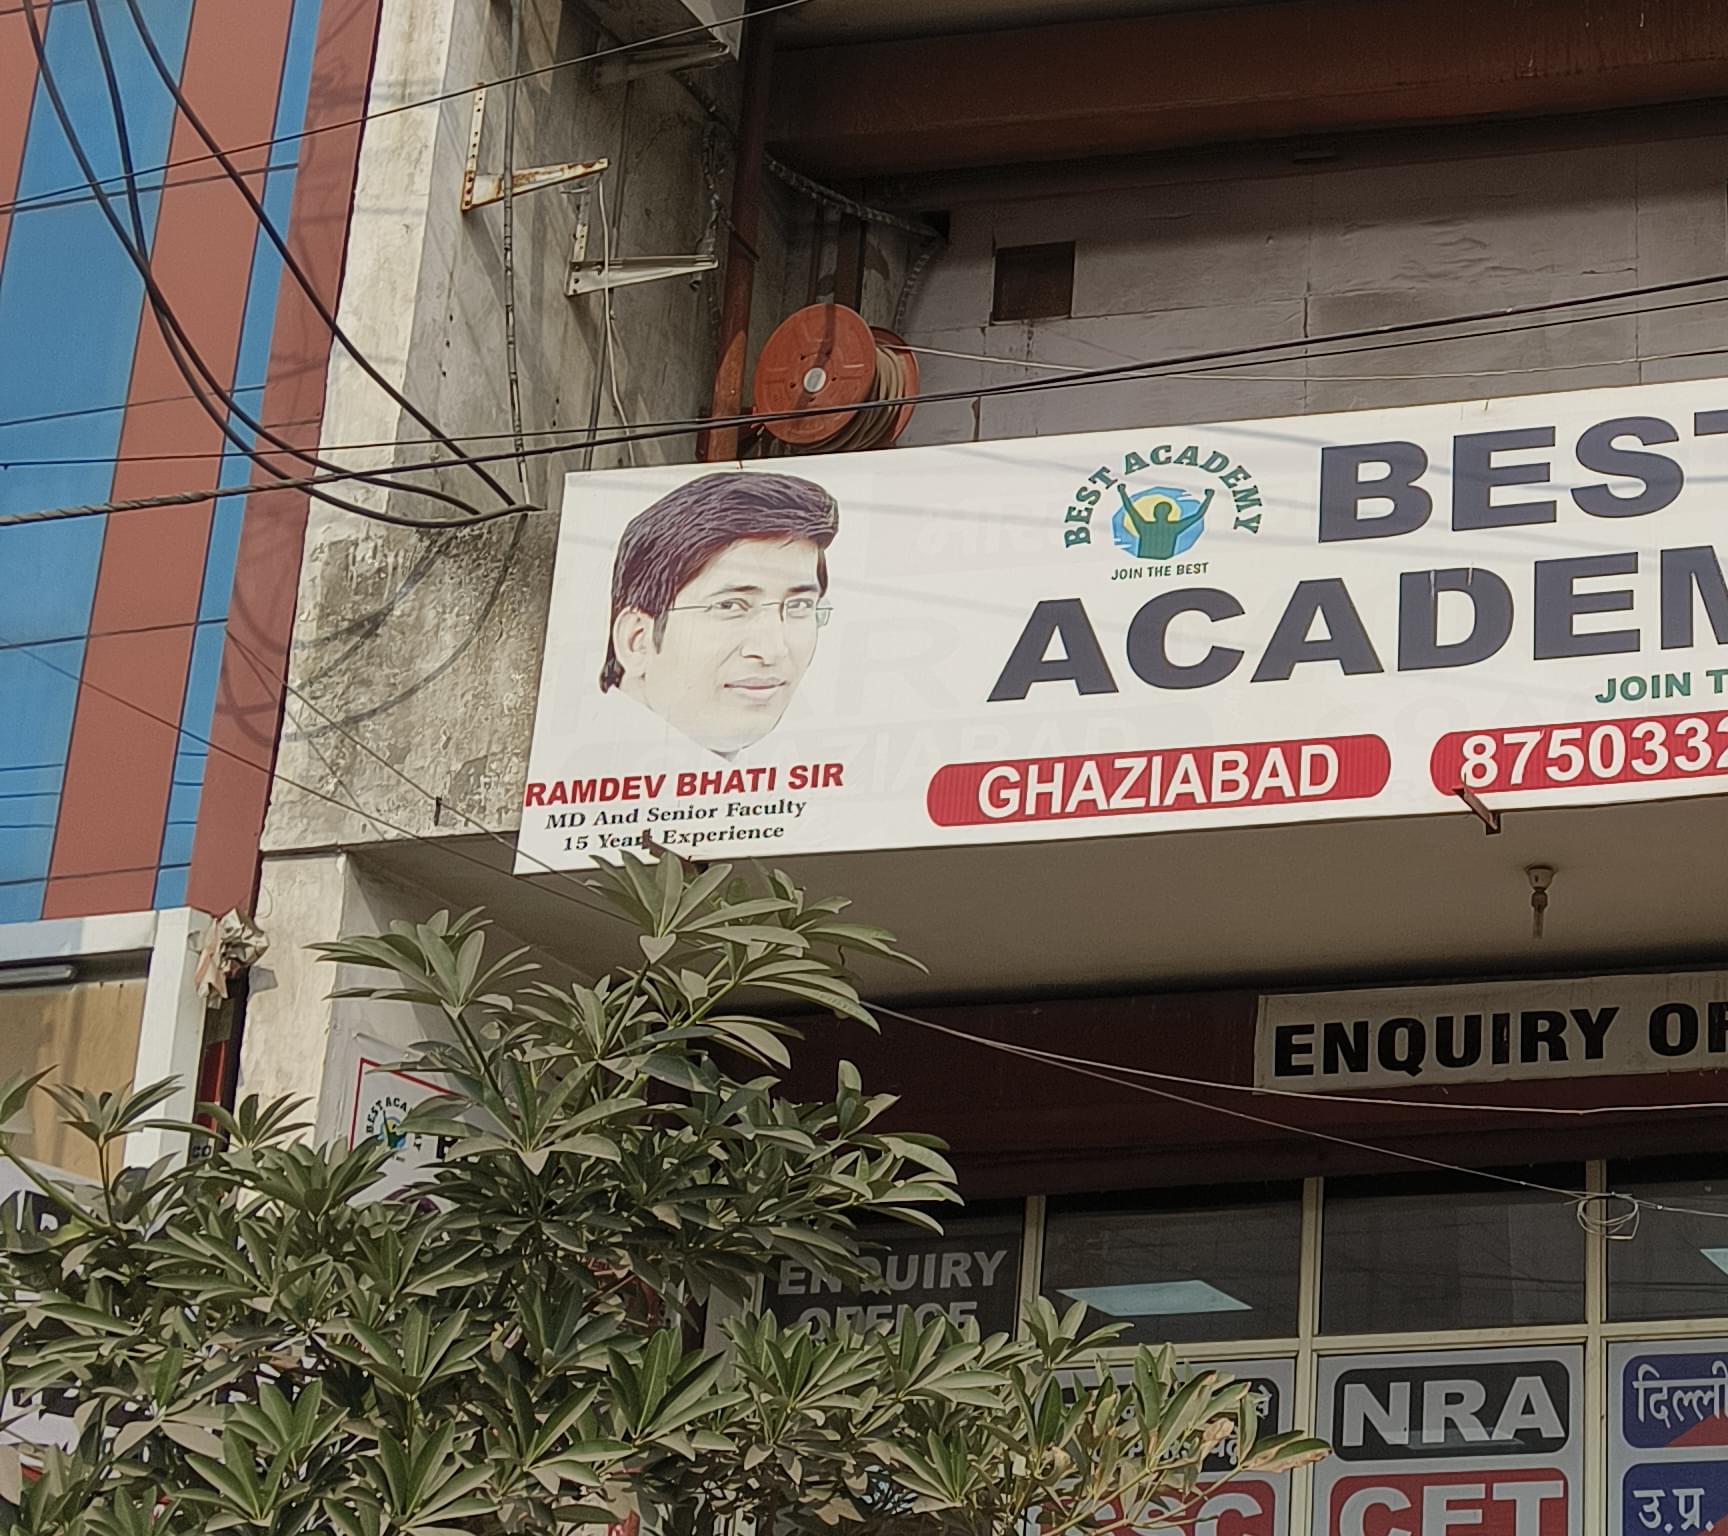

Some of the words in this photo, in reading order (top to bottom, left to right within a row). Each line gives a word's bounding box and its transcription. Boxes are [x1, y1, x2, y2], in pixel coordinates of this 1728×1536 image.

[1063, 466, 1119, 549] BEST
[1124, 444, 1263, 534] ACADEMY
[1111, 567, 1143, 581] JOIN
[1148, 565, 1172, 578] THE
[1176, 562, 1209, 576] BEST
[1594, 671, 1694, 706] JOIN
[525, 773, 666, 807] RAMDEV
[676, 767, 777, 798] BHATI
[787, 762, 845, 791] SIR
[978, 741, 1341, 821] GHAZIABAD
[545, 813, 586, 830] MD
[592, 804, 639, 827] And
[646, 801, 719, 823] Senior
[726, 798, 807, 819] Faculty
[563, 835, 589, 851] 15
[661, 826, 785, 847] Experience
[1273, 1005, 1620, 1079] ENQUIRY
[1342, 1375, 1565, 1447] NRA
